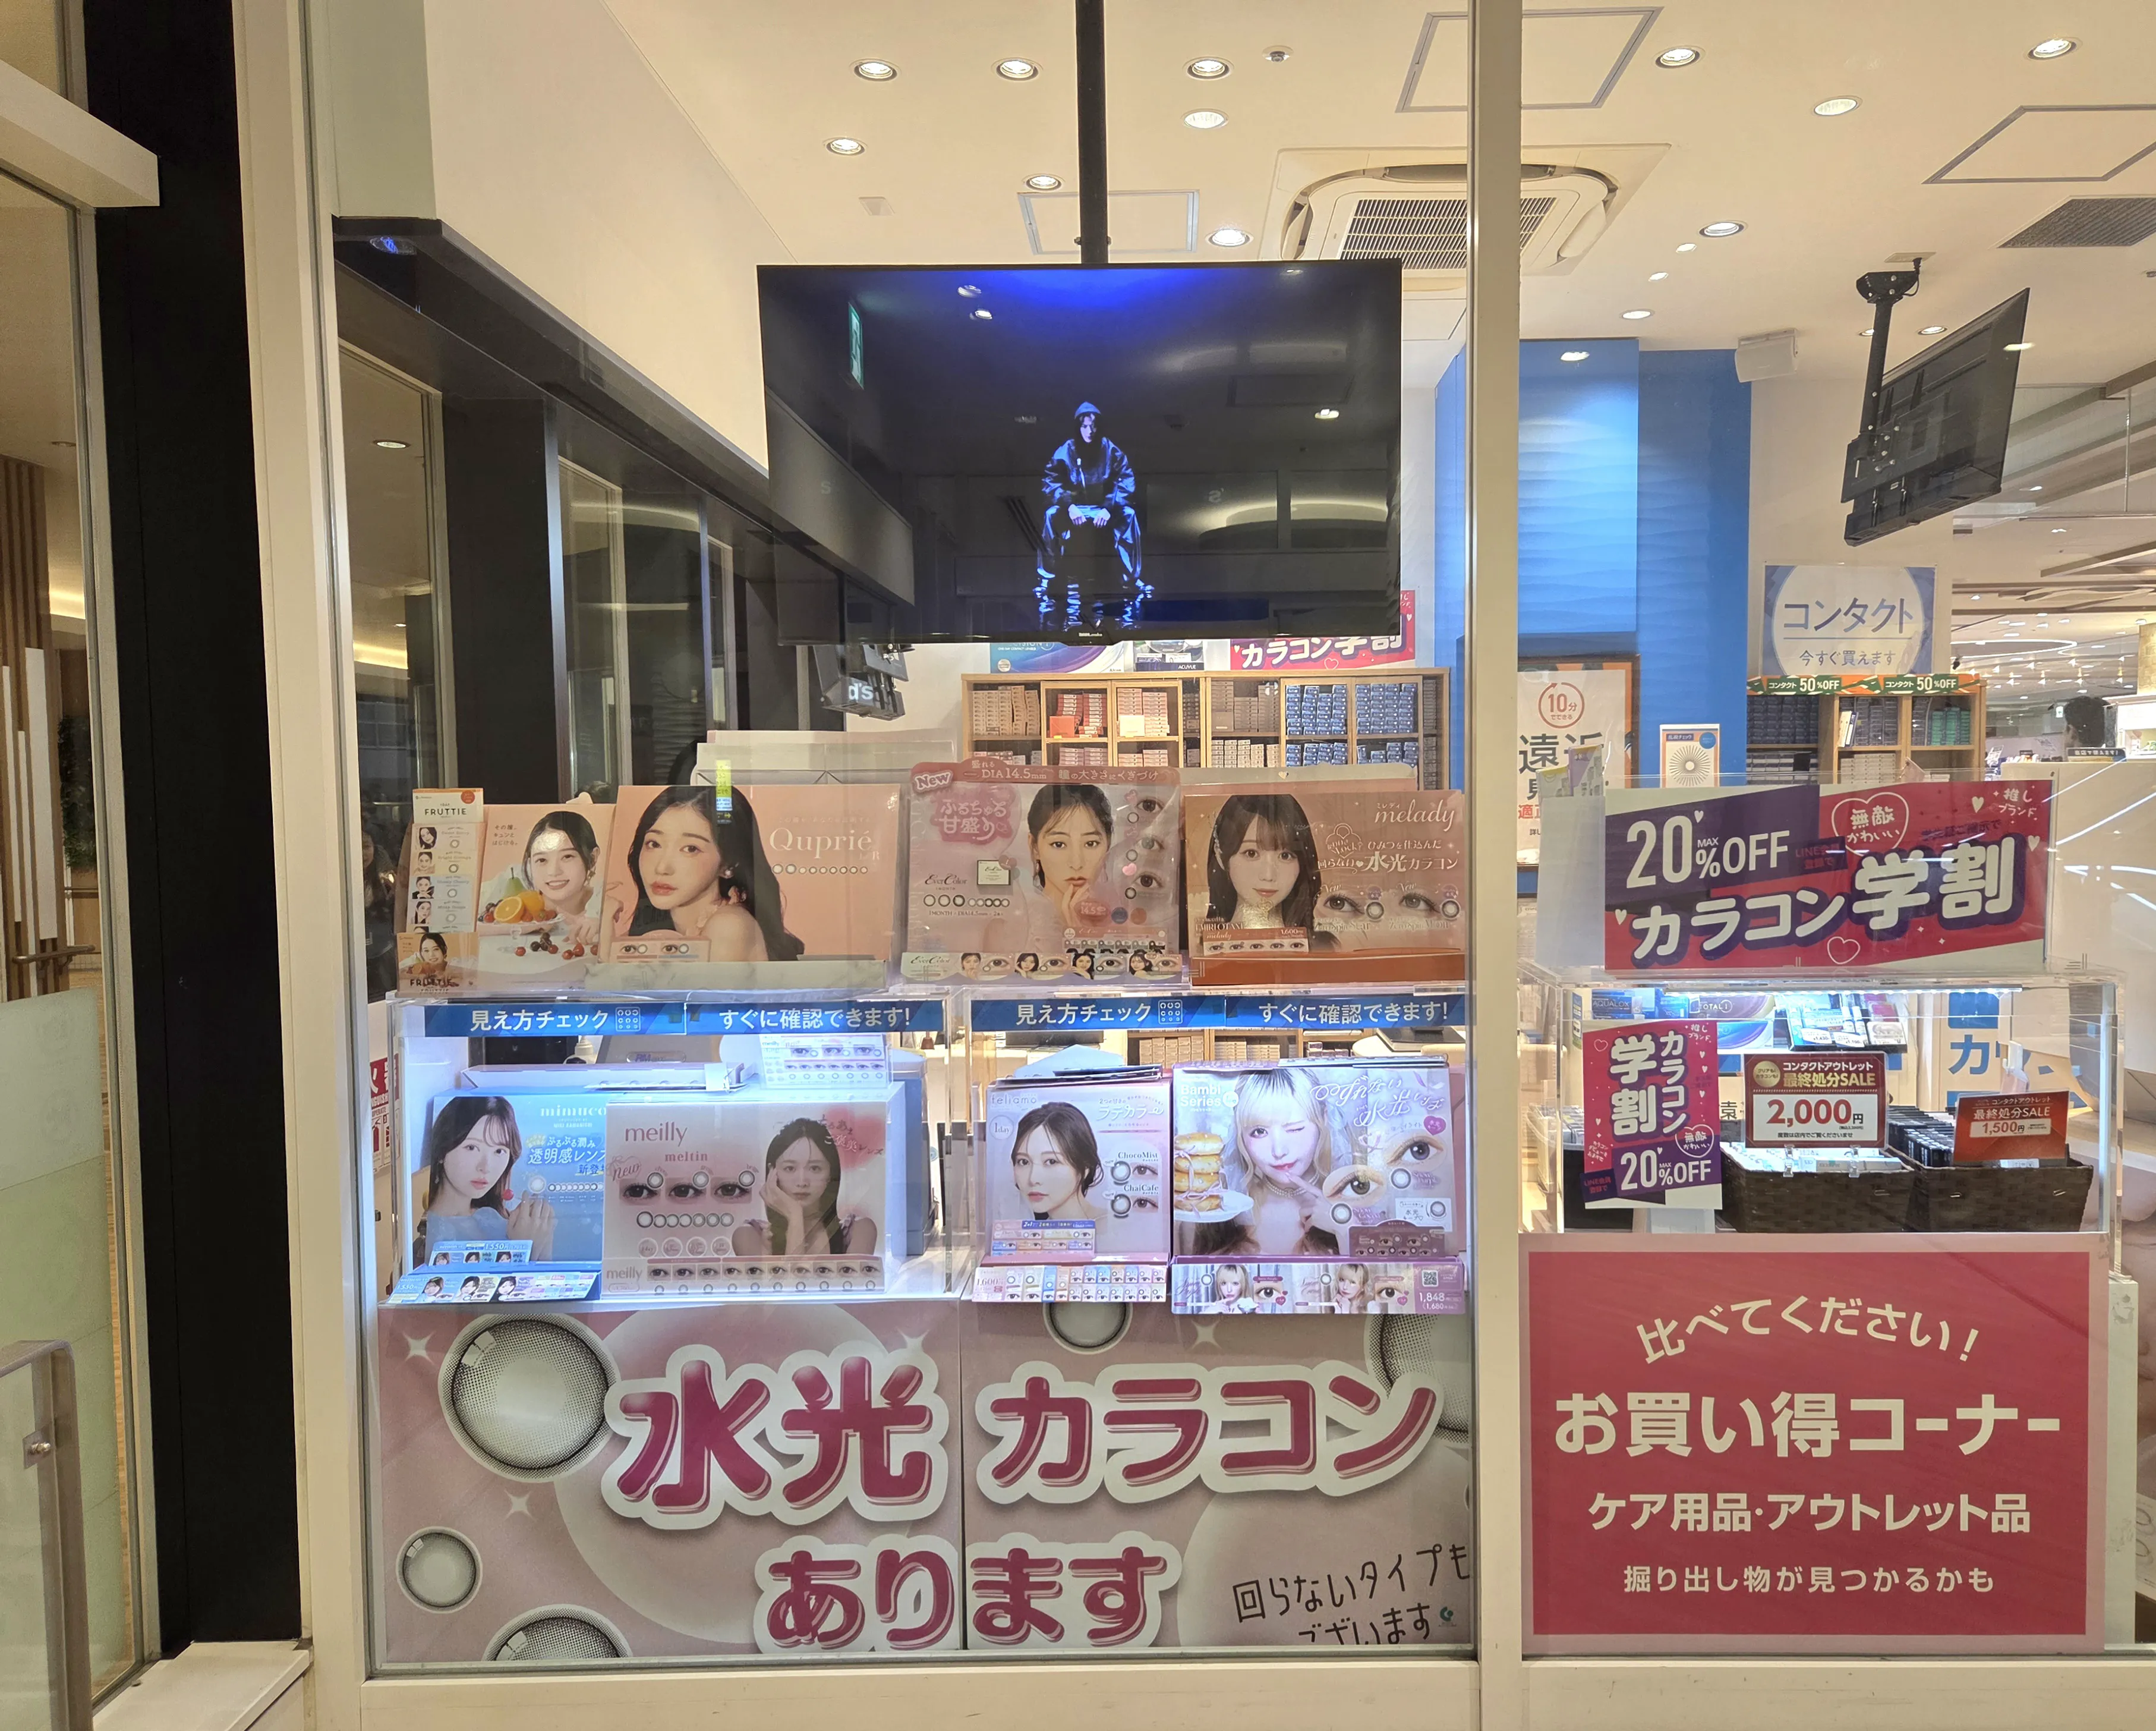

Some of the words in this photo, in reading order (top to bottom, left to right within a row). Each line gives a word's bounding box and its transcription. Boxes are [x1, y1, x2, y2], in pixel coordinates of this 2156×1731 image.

[1784, 597, 1914, 634] コンタクト
[1799, 649, 1896, 666] 今すぐ買えます
[1768, 681, 1797, 690] コンタクト
[1799, 678, 1840, 692] 50%OFF
[1917, 676, 1957, 691] 50%OFF
[1547, 693, 1577, 713] 10分
[971, 760, 995, 769] 盛れる
[916, 772, 951, 789] New
[1059, 770, 1158, 780] 瞳の大きさにくぎづけ
[2004, 788, 2032, 802] 推し
[1375, 798, 1455, 832] melady
[1850, 805, 1895, 830] 無敵
[1999, 803, 2037, 817] ブランド
[938, 816, 995, 841] 甘盛り
[1847, 829, 1900, 844] かわいい
[770, 827, 872, 859] Quprié
[1367, 839, 1442, 850] ひみつを仕込んだ
[1697, 837, 1719, 848] MAX
[1360, 851, 1458, 873] 水光カラコン
[1593, 999, 1631, 1008] AQUALOX
[470, 1009, 609, 1032] 見え方チェック
[719, 1008, 910, 1030] すぐに確認できます!
[1016, 1003, 1152, 1026] 見え方チェック
[1259, 1001, 1448, 1025] すぐに確認できます!
[1690, 1023, 1708, 1033] 推し
[1688, 1033, 1711, 1041] ブランド
[1783, 1062, 1873, 1071] コンタクトアウトレット
[1609, 1033, 1657, 1136] 学割
[1659, 1030, 1688, 1134] カラコン
[1783, 1072, 1876, 1088] 最終処分SALE
[991, 1094, 1037, 1104] feliamo
[1180, 1095, 1222, 1107] Series
[1991, 1096, 2050, 1106] コンタクトアウトレット
[1766, 1099, 1864, 1128] 2,000円
[1974, 1106, 2050, 1121] 最終処分SALE
[625, 1121, 688, 1147] meilly
[994, 1122, 1009, 1134] 1day
[1982, 1121, 2025, 1135] 1,500円
[1684, 1131, 1707, 1143] 無敵
[1683, 1141, 1710, 1151] かわいい
[664, 1151, 708, 1162] meltin
[606, 1266, 642, 1282] meilly
[1419, 1292, 1445, 1302] 1,848
[1635, 1295, 1980, 1365] 比べてください!
[1554, 1391, 2060, 1459] お買い得コーナー
[1588, 1493, 2031, 1533] ケア用品・アウトレット品
[1233, 1543, 1470, 1623] 回らないタイプも
[1624, 1565, 1994, 1594] 掘り出し物が見つかるかも
[765, 1545, 1169, 1651] あります
